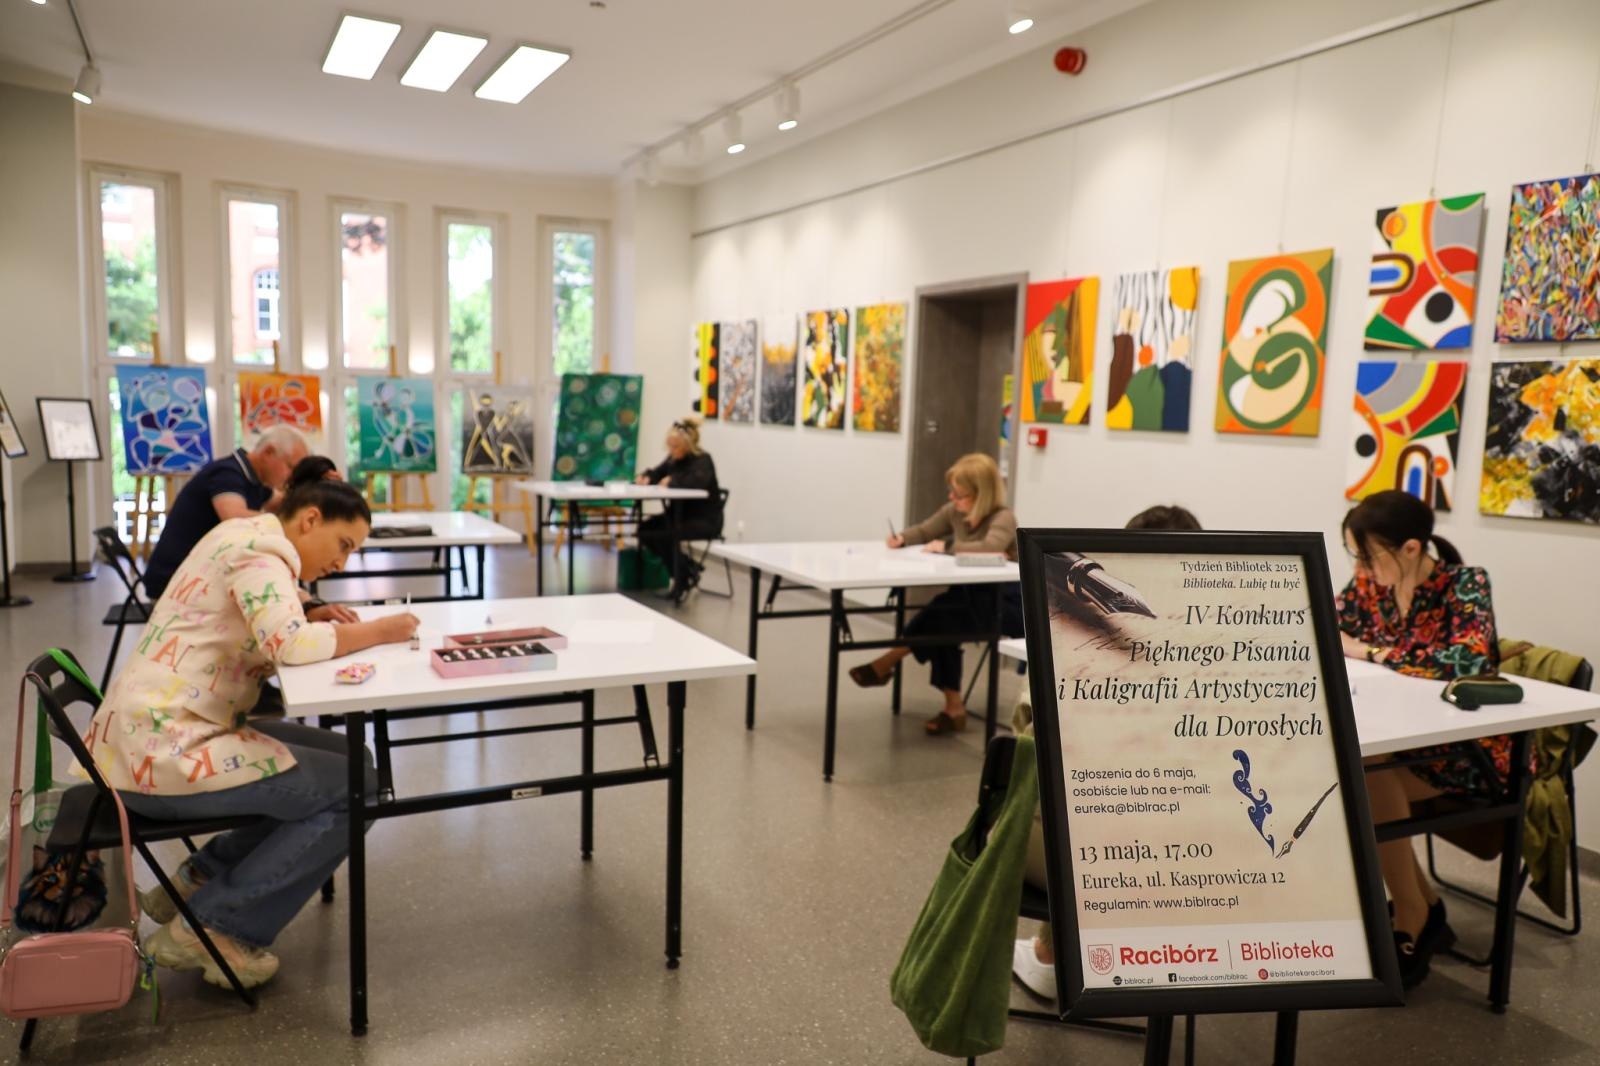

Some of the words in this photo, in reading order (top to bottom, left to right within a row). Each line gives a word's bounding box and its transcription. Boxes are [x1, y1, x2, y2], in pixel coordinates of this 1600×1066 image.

[1181, 562, 1223, 573] Tydzień
[1226, 562, 1273, 572] Bibliotek
[1275, 564, 1298, 573] 2025
[1183, 578, 1236, 589] Biblioteka.
[1239, 578, 1267, 590] Lubię
[1270, 580, 1280, 589] tu
[1283, 578, 1300, 590] być
[1185, 606, 1211, 626] IV
[1217, 605, 1305, 625] Konkurs
[1130, 641, 1225, 666] Pięknego
[1232, 640, 1311, 662] Pisania
[1058, 678, 1066, 700] i
[1072, 678, 1178, 704] Kaligrafii
[1184, 677, 1317, 703] Artystycznej
[1175, 715, 1208, 737] dla
[1216, 713, 1323, 740] Dorosłych
[1072, 769, 1132, 781] Zgłoszenia
[1135, 768, 1150, 778] do
[1153, 768, 1160, 778] 6
[1163, 768, 1196, 780] maja,
[1073, 785, 1127, 797] osobiście
[1130, 785, 1148, 795] lub
[1151, 786, 1166, 795] na
[1170, 784, 1211, 794] e-mail:
[1075, 801, 1180, 814] eureka@biblrac.pl
[1080, 846, 1098, 864] 13
[1104, 840, 1158, 863] maja,
[1164, 843, 1212, 861] 17.00
[1082, 873, 1142, 890] Eureka,
[1147, 872, 1166, 887] ul.
[1171, 869, 1267, 889] Kasprowicza
[1271, 872, 1285, 884] 12
[1084, 898, 1151, 913] Regulamin:
[1153, 896, 1238, 909] www.biblrac.pl
[1120, 944, 1218, 965] Racibórz
[1241, 940, 1334, 960] Biblioteka
